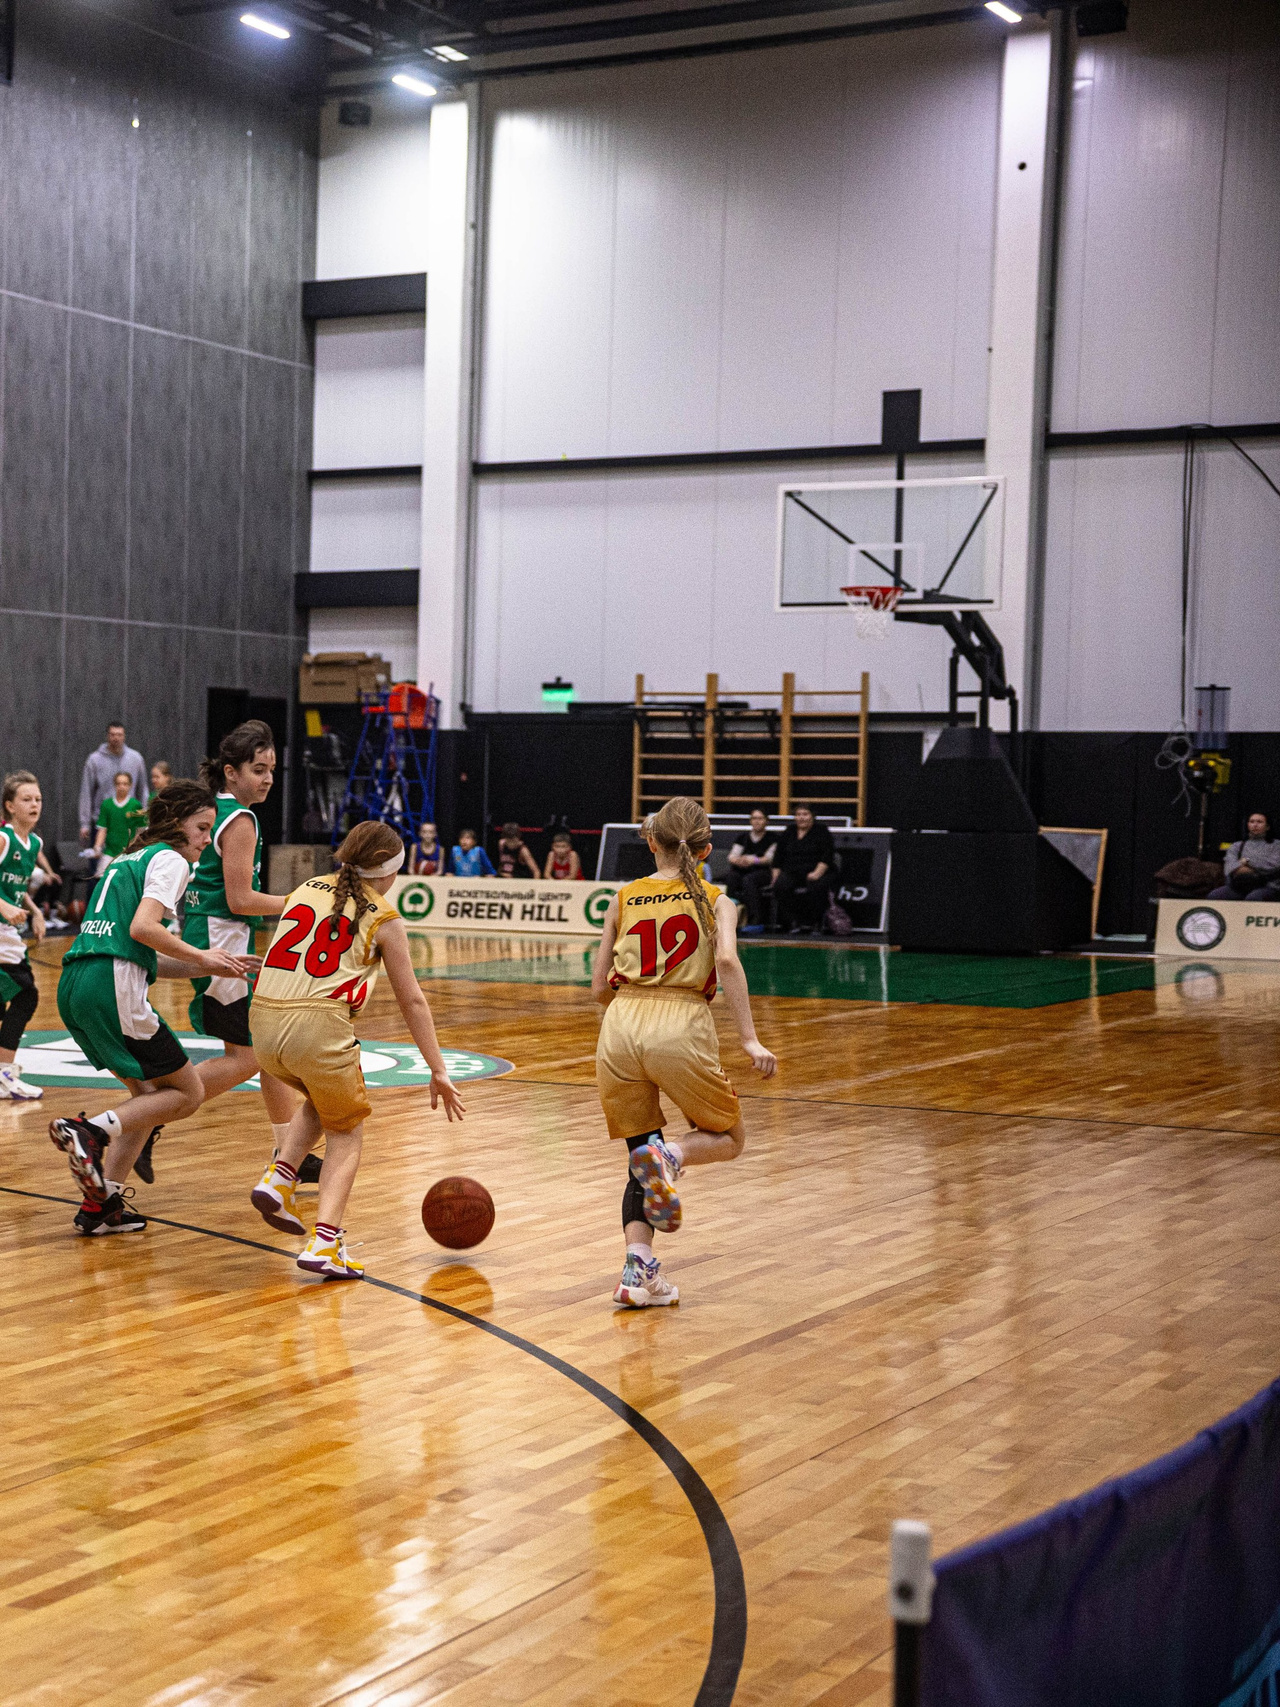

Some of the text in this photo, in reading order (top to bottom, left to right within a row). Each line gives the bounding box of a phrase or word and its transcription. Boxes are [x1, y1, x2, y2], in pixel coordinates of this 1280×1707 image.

[94, 868, 118, 914] 1
[305, 879, 379, 914] СЕРПВ
[447, 888, 572, 902] БАСКЕТБОЛЬНЫЙ ЦЕНТР
[80, 919, 116, 939] ИПЕЦК
[446, 901, 513, 921] GREEN
[520, 903, 570, 923] HILL
[264, 903, 355, 978] 28
[626, 913, 700, 978] 19
